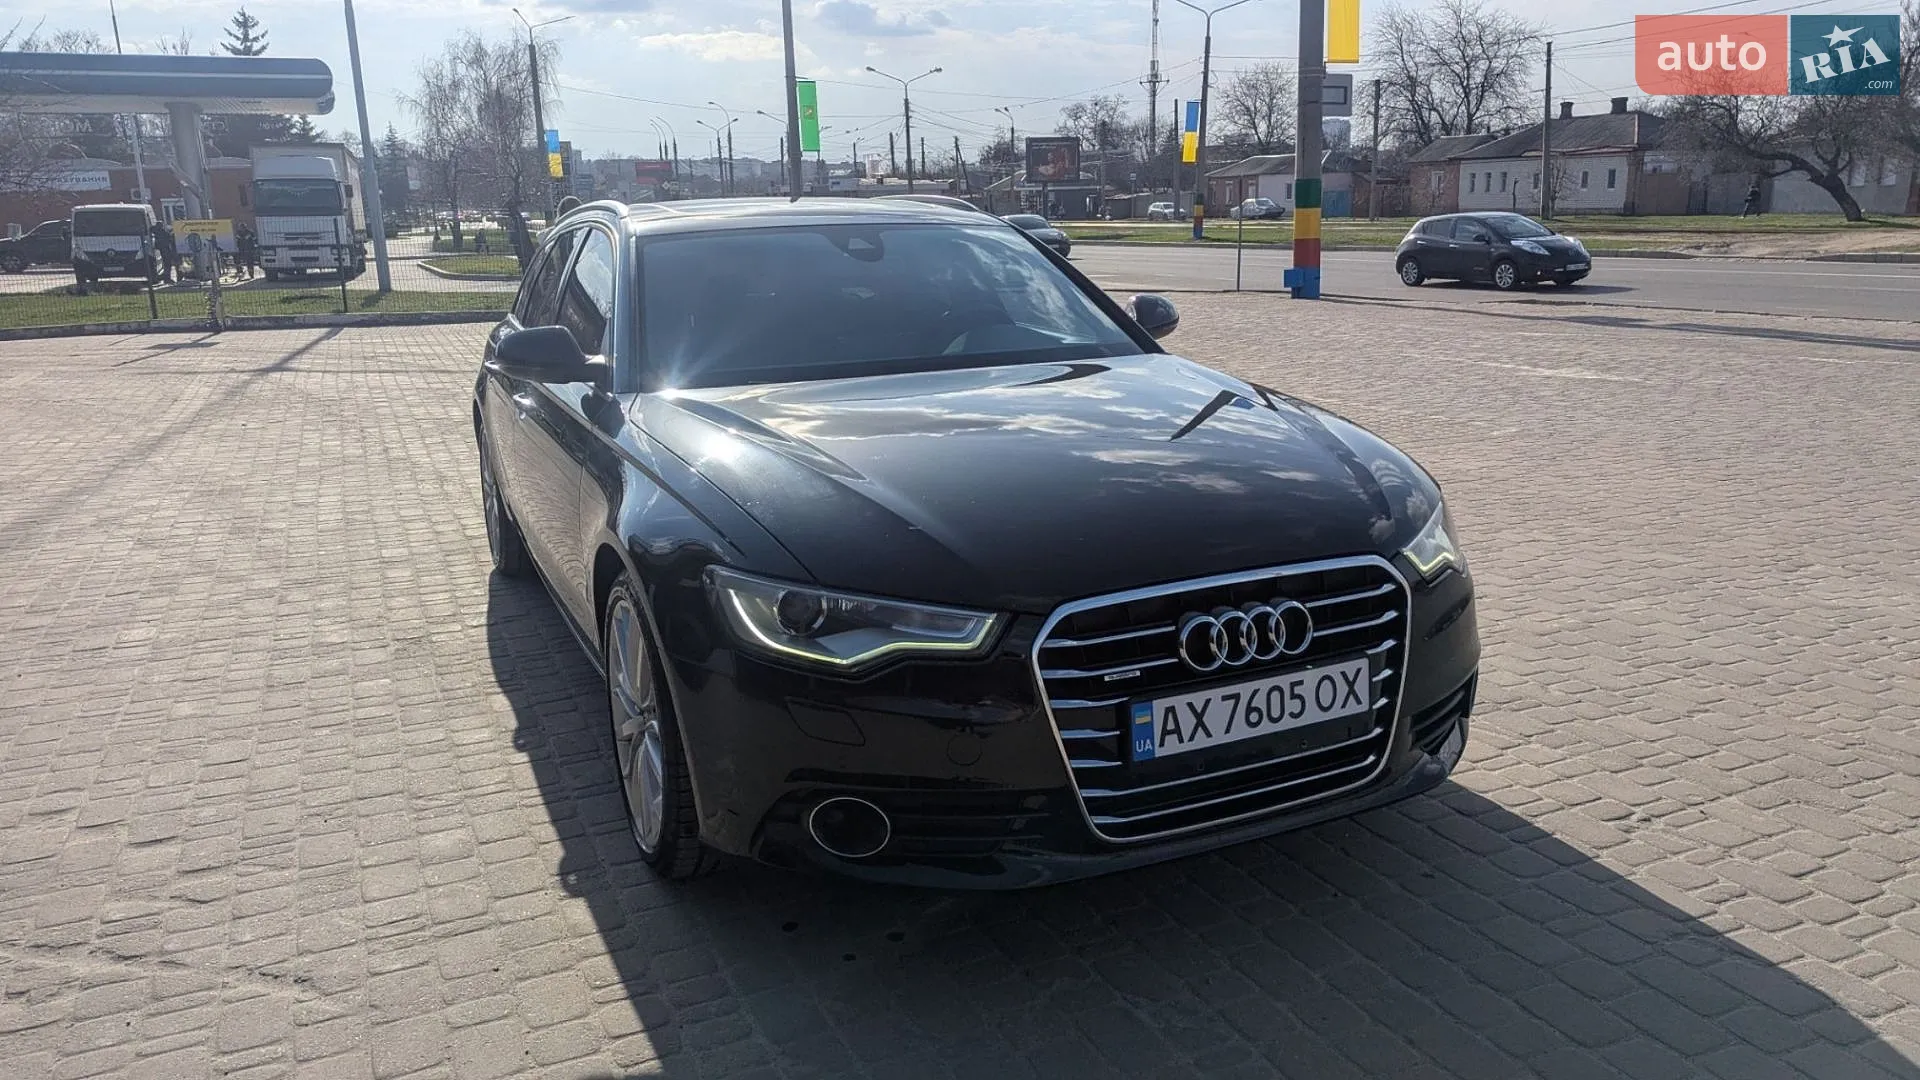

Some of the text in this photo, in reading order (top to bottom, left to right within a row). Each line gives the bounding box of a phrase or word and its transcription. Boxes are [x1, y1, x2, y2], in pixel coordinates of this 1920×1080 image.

[1158, 667, 1363, 748] AX 7605 OX
[1136, 740, 1153, 753] UA
